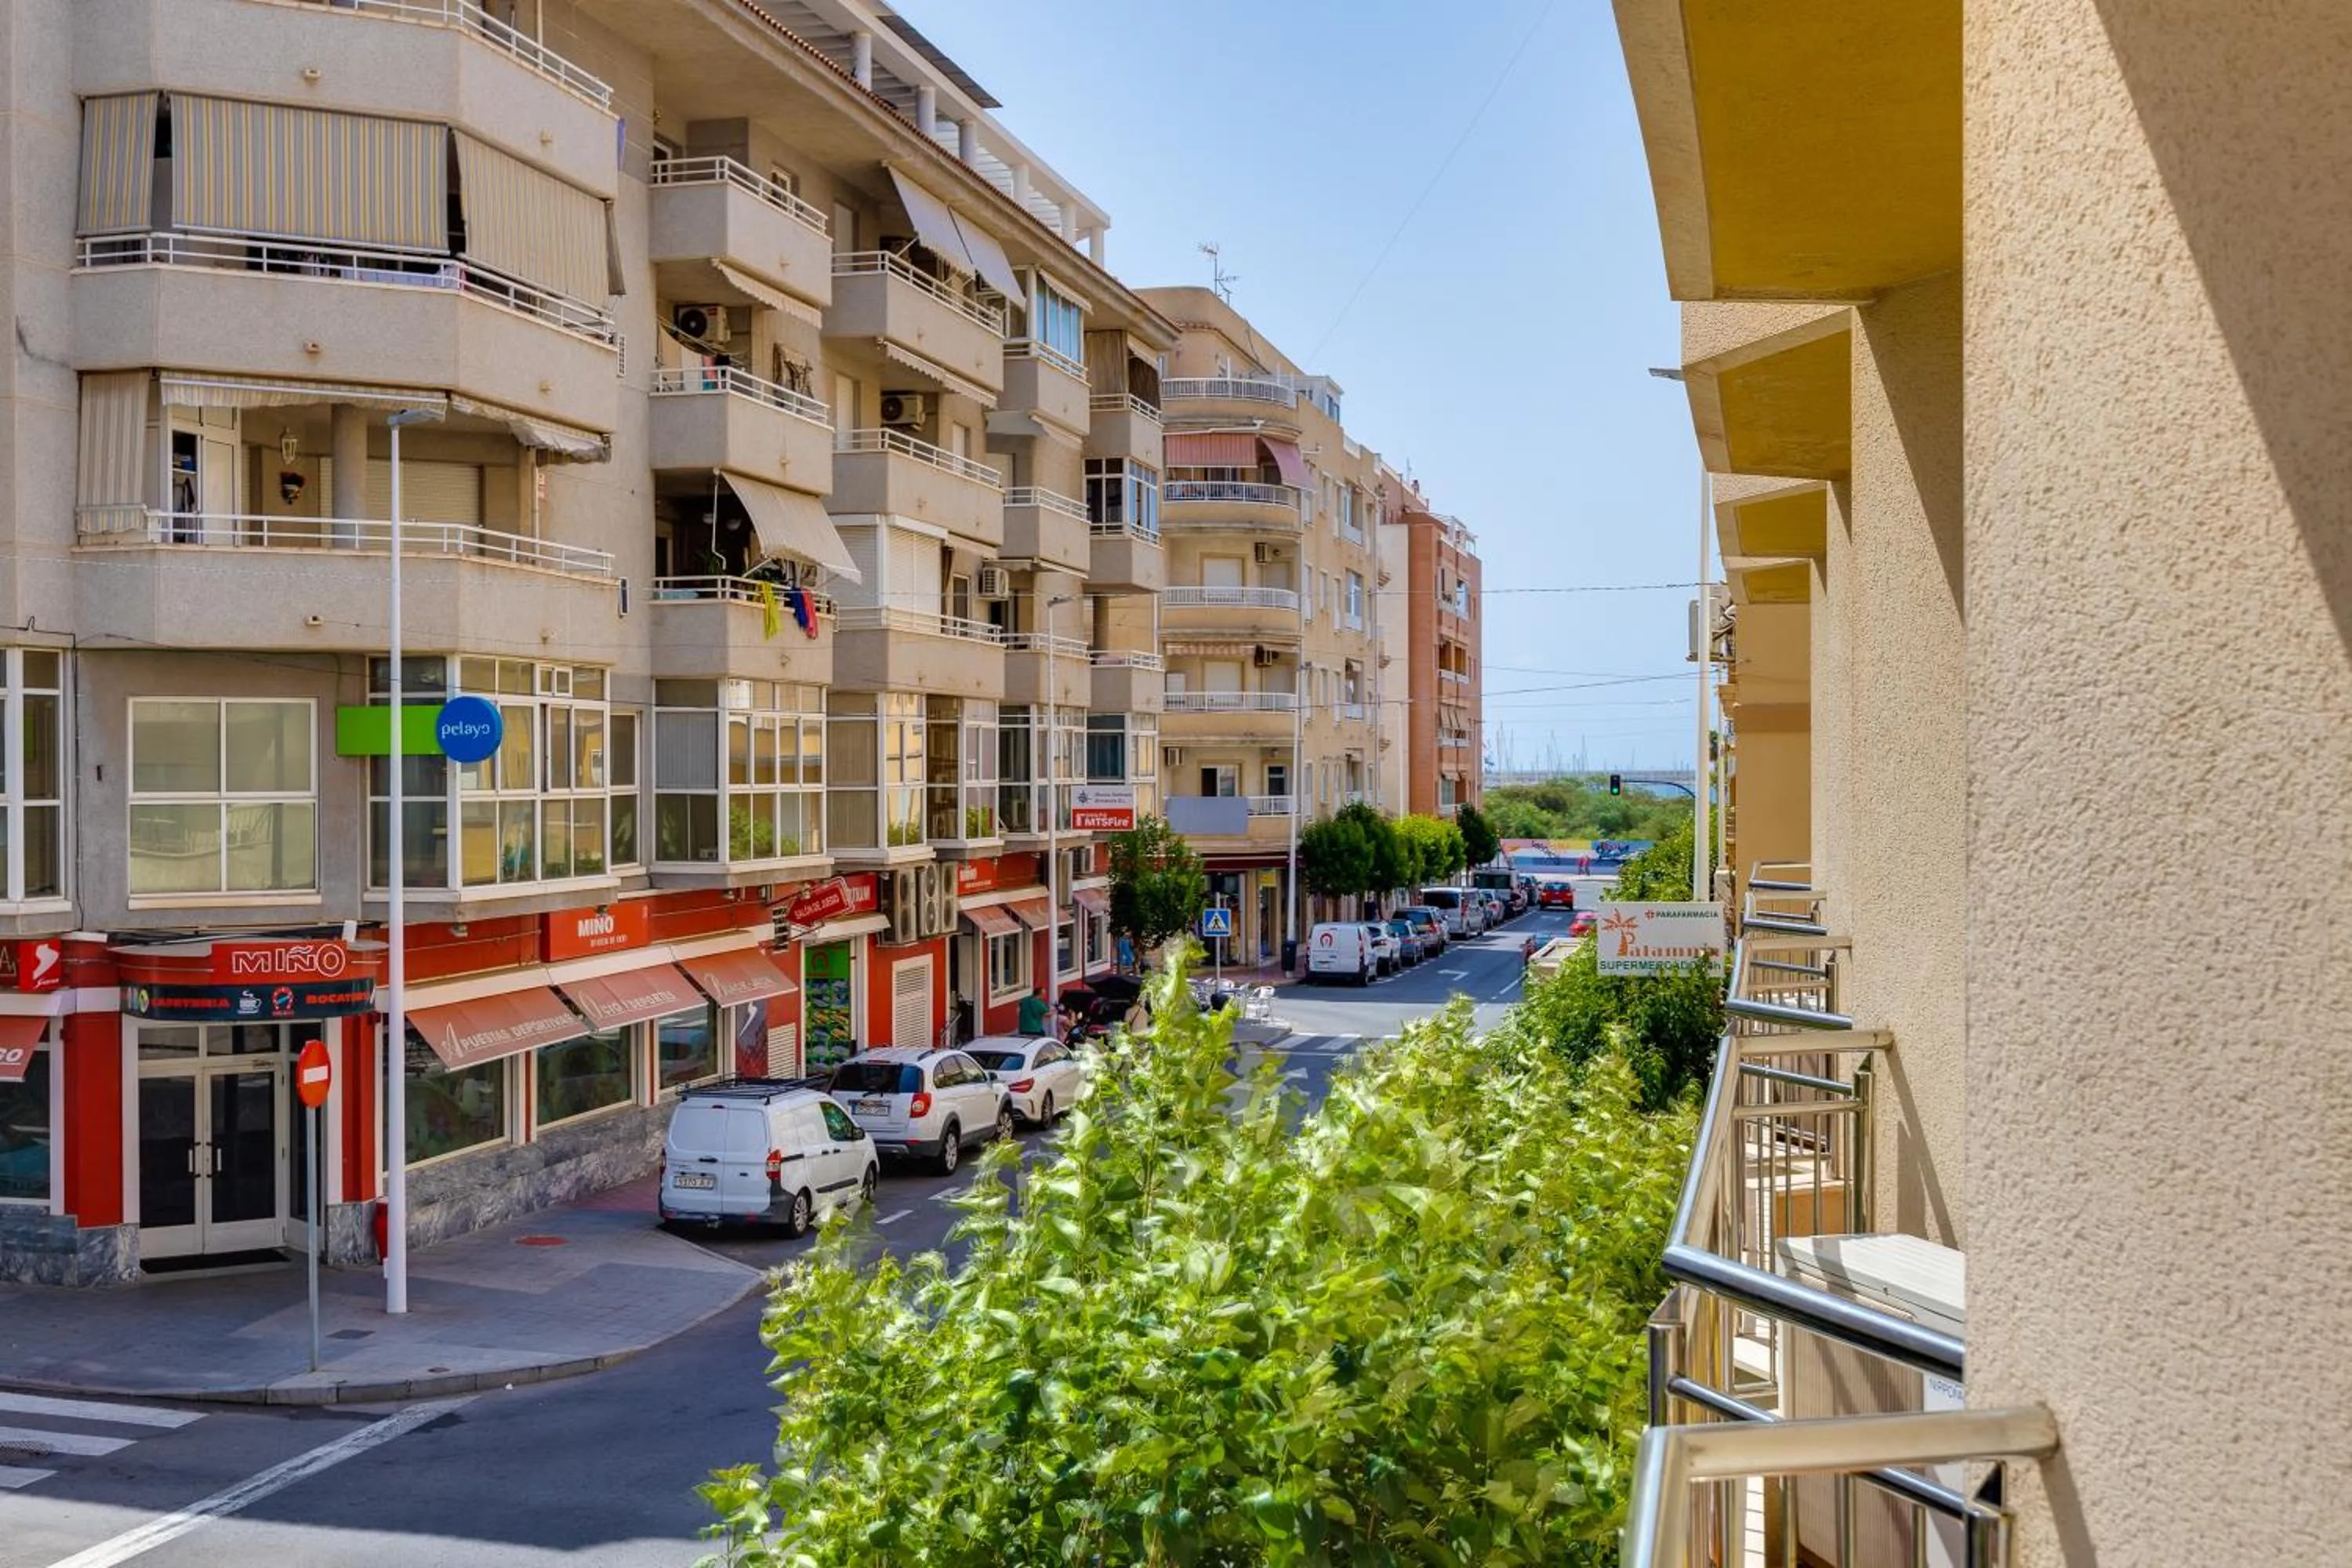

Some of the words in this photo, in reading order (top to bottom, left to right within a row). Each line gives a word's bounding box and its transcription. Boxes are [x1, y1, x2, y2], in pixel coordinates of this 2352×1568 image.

[441, 720, 490, 739] pelayo
[1656, 909, 1719, 918] PARAFARMACIA
[232, 943, 346, 977] MIÑO
